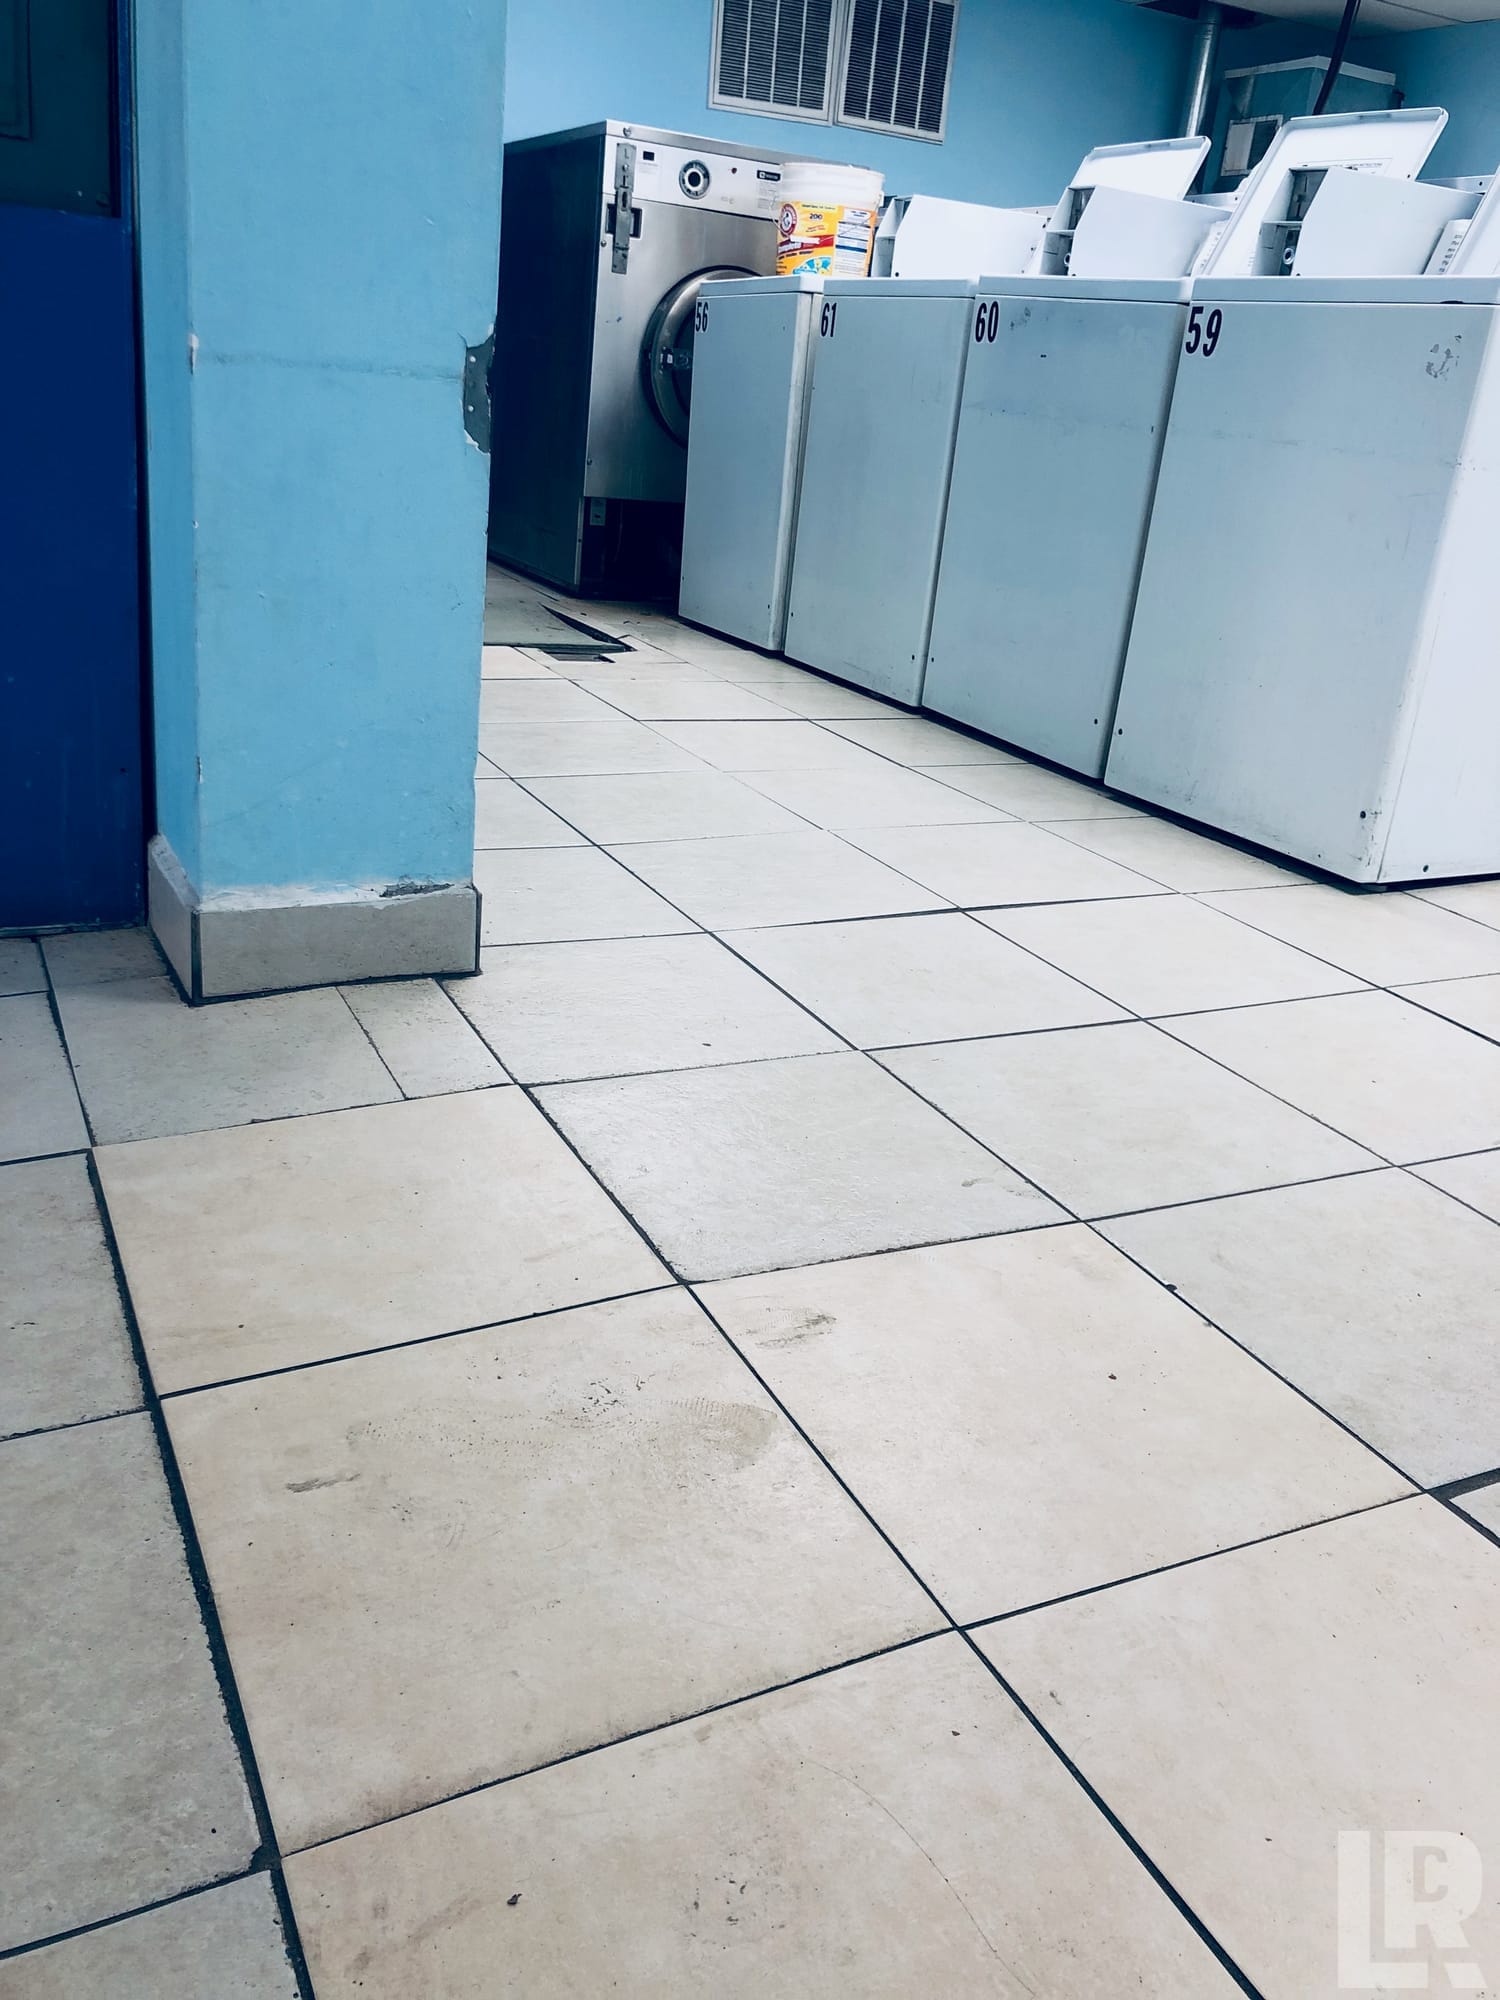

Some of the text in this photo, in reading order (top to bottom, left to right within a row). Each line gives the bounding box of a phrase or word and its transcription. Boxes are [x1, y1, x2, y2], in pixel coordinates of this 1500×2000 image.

[695, 301, 709, 332] 56
[820, 302, 837, 337] 61
[975, 301, 999, 343] 60
[1185, 305, 1223, 357] 59
